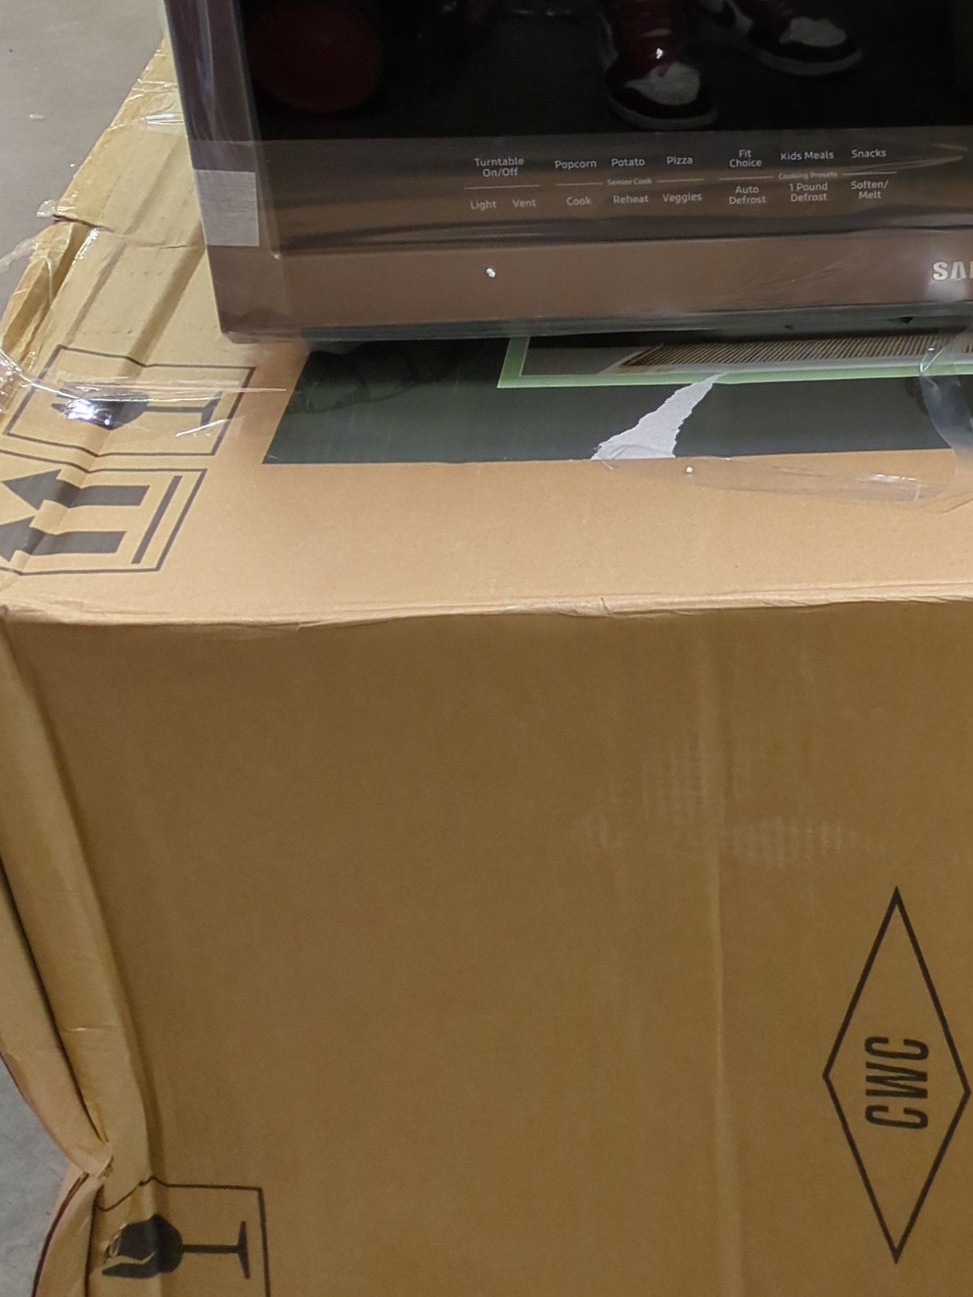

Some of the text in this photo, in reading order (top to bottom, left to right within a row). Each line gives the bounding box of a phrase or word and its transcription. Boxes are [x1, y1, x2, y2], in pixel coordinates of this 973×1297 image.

[738, 149, 752, 158] Fit
[780, 151, 834, 161] Kids Meals
[851, 148, 887, 159] Snacks
[474, 156, 524, 167] Turntable
[555, 160, 597, 170] Popcorn
[611, 158, 645, 167] Potato
[666, 156, 693, 165] Pizza
[729, 158, 762, 168] Choice
[482, 167, 519, 177] On/Off
[634, 177, 652, 185] Cook
[851, 180, 889, 190] Soften/
[735, 185, 759, 194] Auto
[789, 182, 828, 192] 1 Pound
[613, 195, 648, 204] Reheat
[662, 192, 702, 205] Veggies
[729, 195, 767, 205] Defrost
[790, 192, 828, 202] Defrost
[858, 190, 881, 200] Melt
[470, 200, 497, 211] Light
[512, 199, 536, 208] Vent
[566, 196, 592, 206] Cook
[864, 1036, 929, 1129] CWC
